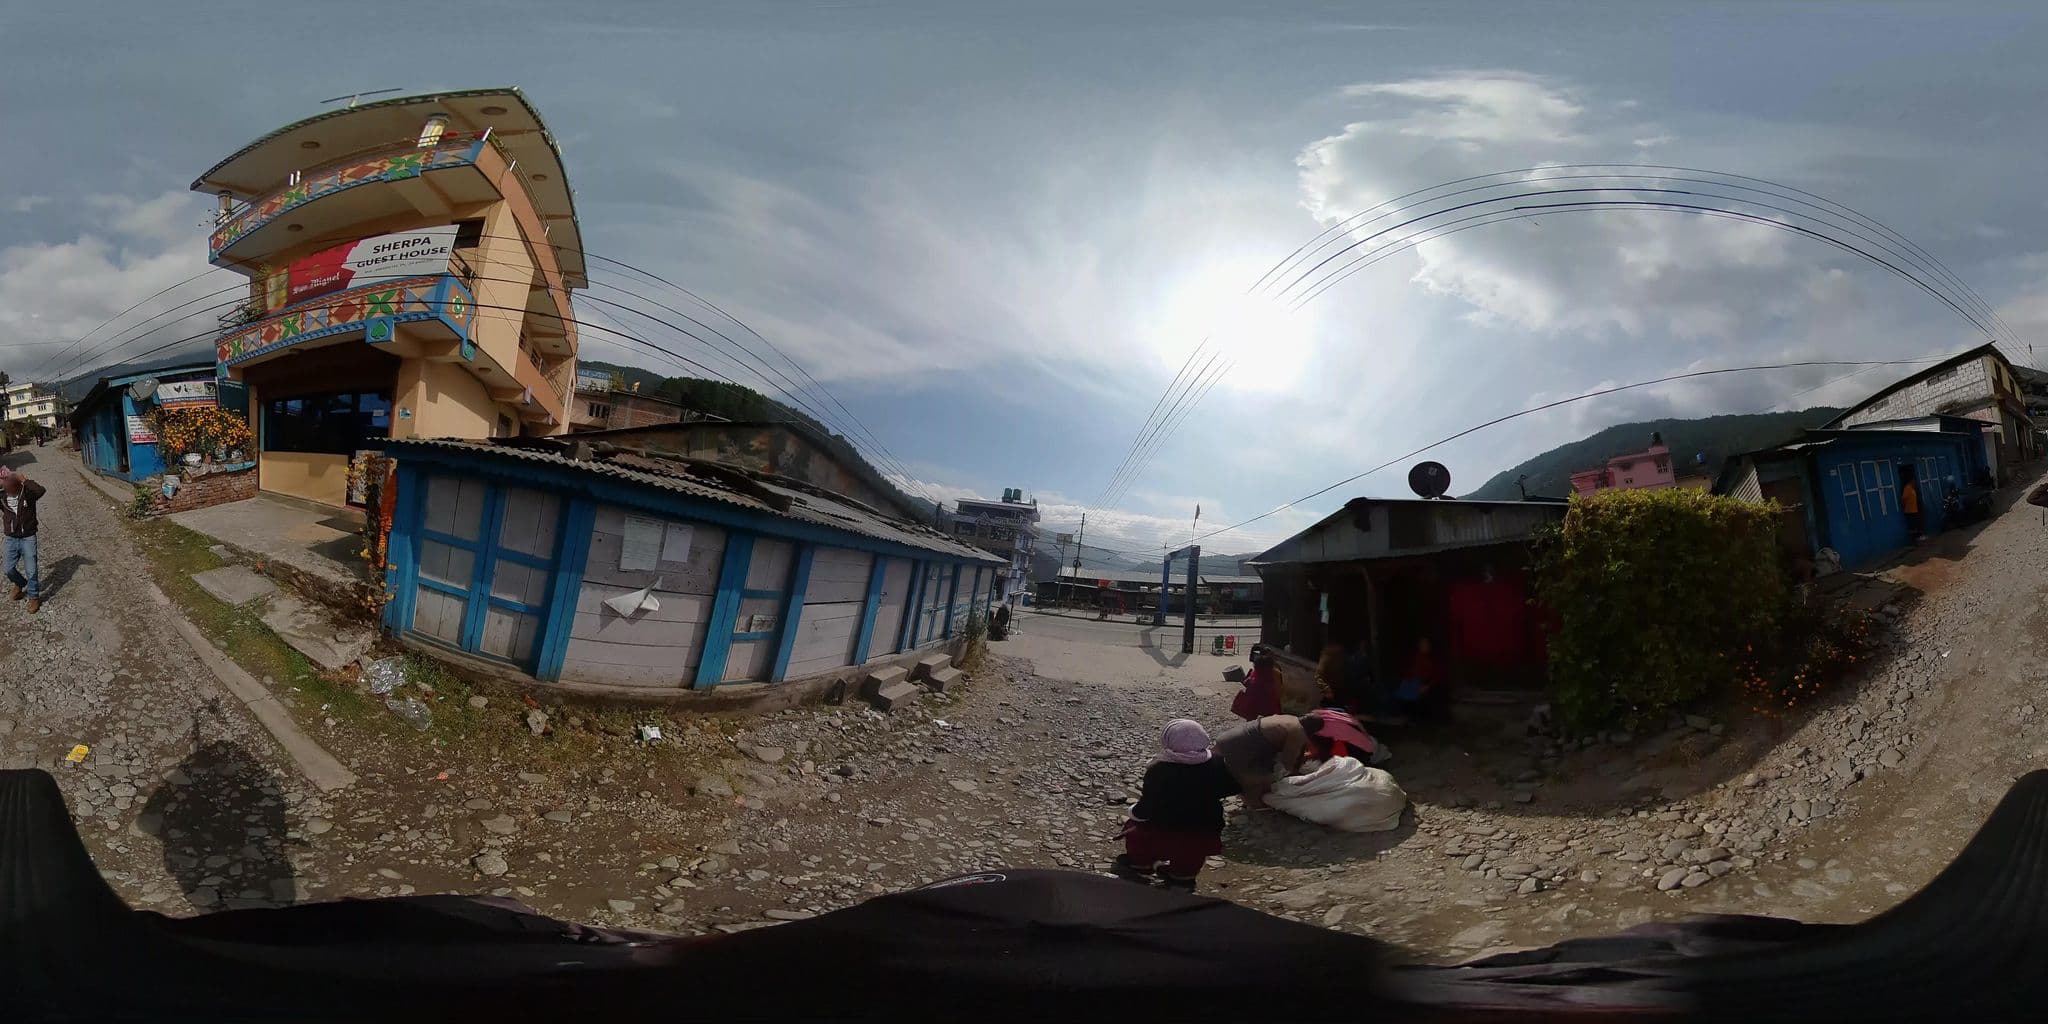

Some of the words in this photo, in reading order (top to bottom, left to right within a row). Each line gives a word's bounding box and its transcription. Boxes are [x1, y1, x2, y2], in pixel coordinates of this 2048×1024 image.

[372, 236, 431, 254] SHERPA
[356, 253, 397, 268] GUEST
[399, 246, 448, 260] HOUSE
